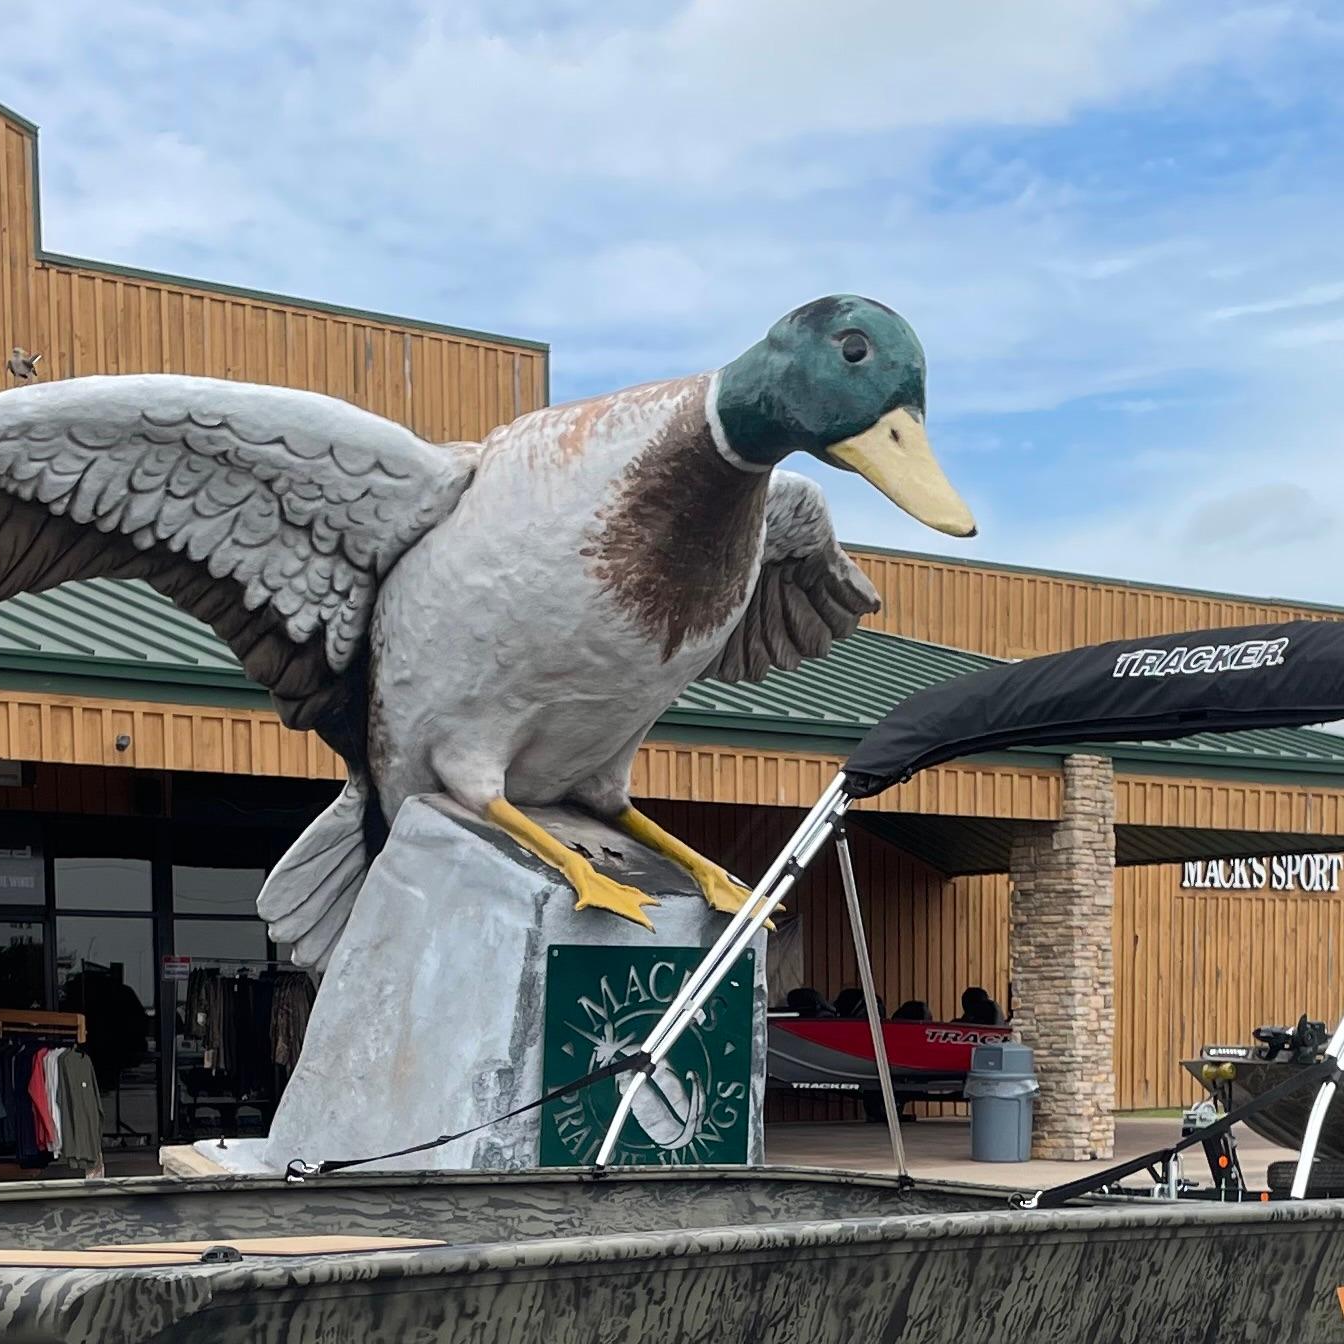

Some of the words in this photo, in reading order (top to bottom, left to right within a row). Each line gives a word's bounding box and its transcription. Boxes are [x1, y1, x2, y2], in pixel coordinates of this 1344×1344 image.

[1113, 638, 1286, 677] TRACKER
[1182, 856, 1267, 889] MACK'S
[1271, 853, 1343, 892] SPORT
